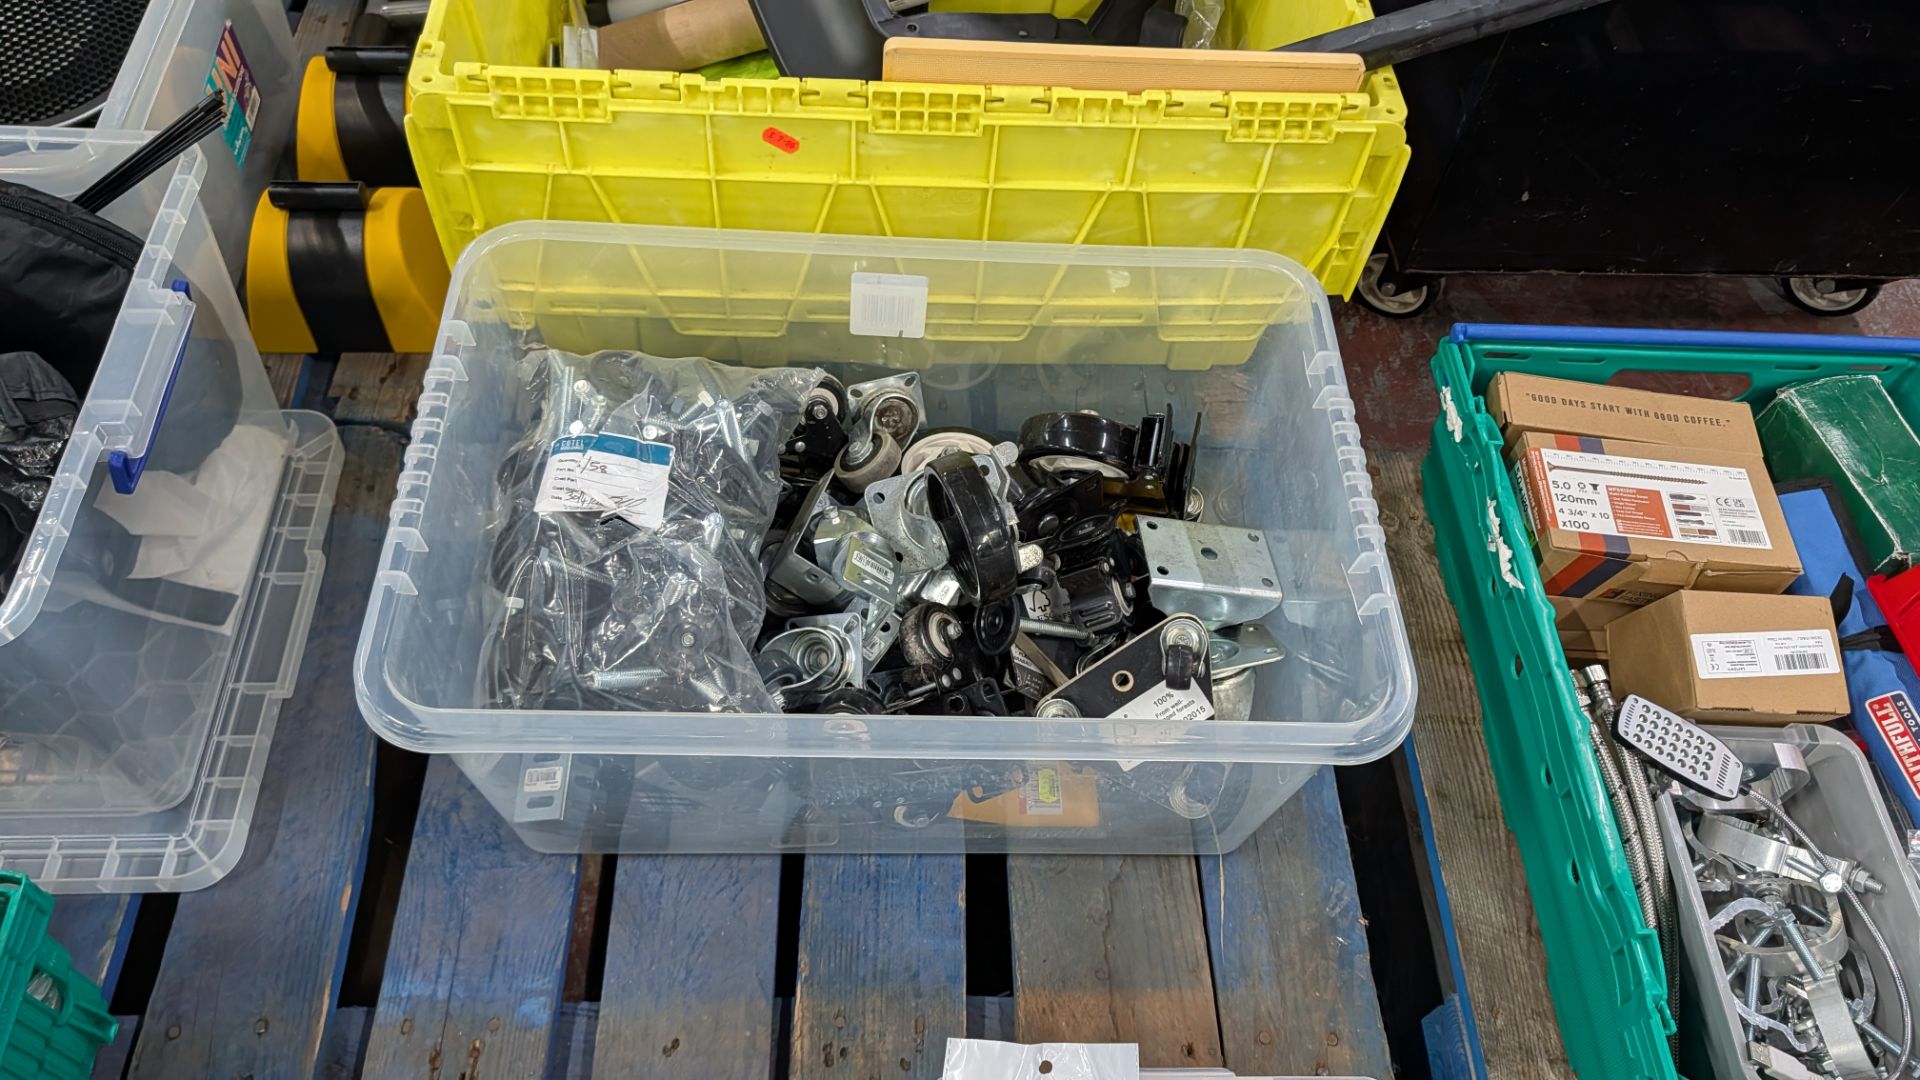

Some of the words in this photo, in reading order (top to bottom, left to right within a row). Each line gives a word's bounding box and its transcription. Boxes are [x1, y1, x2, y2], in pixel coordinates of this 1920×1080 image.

[1561, 398, 1587, 409] DAYS
[1590, 402, 1621, 413] START
[1625, 407, 1650, 418] WITH
[1653, 411, 1680, 422] GOOD
[1552, 480, 1571, 490] 5.0
[1555, 493, 1598, 506] 120mm
[1599, 512, 1610, 520] 10
[1562, 520, 1590, 530] x100
[1153, 692, 1175, 708] 100%
[1177, 699, 1196, 713] forests
[1155, 707, 1170, 718] From
[1181, 705, 1206, 720] 02015
[1896, 700, 1919, 732] TOOLS
